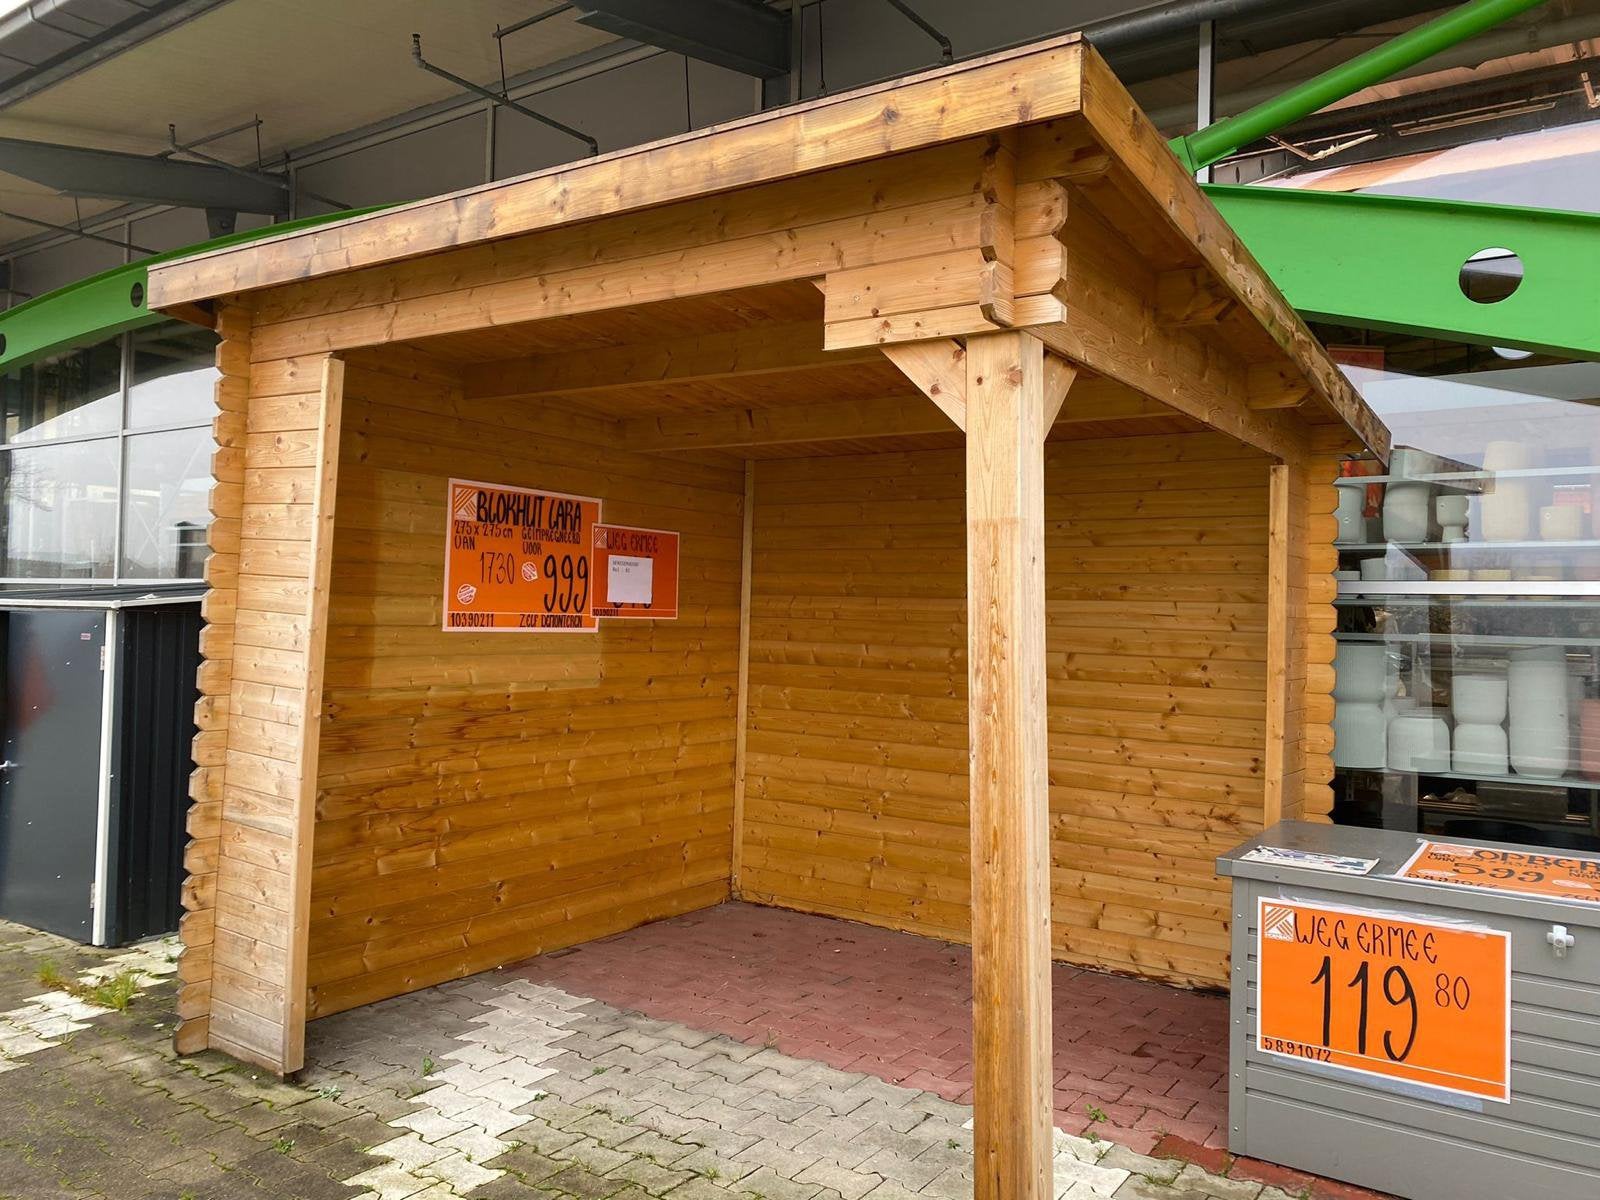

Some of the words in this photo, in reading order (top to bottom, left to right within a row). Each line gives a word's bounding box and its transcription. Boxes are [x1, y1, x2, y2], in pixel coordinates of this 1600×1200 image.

[477, 490, 545, 529] BLOKHUT
[550, 499, 582, 532] LARA
[455, 519, 472, 535] 275
[482, 523, 502, 537] 275
[607, 530, 627, 550] WEG
[454, 535, 475, 550] VAN
[522, 541, 542, 555] VOOR
[480, 551, 515, 584] 1730
[543, 554, 588, 613] 999
[451, 612, 494, 627] 10390211
[1452, 861, 1545, 883] 599
[1294, 912, 1349, 950] WEG
[1356, 921, 1438, 964] ERMEE
[1434, 972, 1470, 1010] 80
[1310, 955, 1418, 1062] 119
